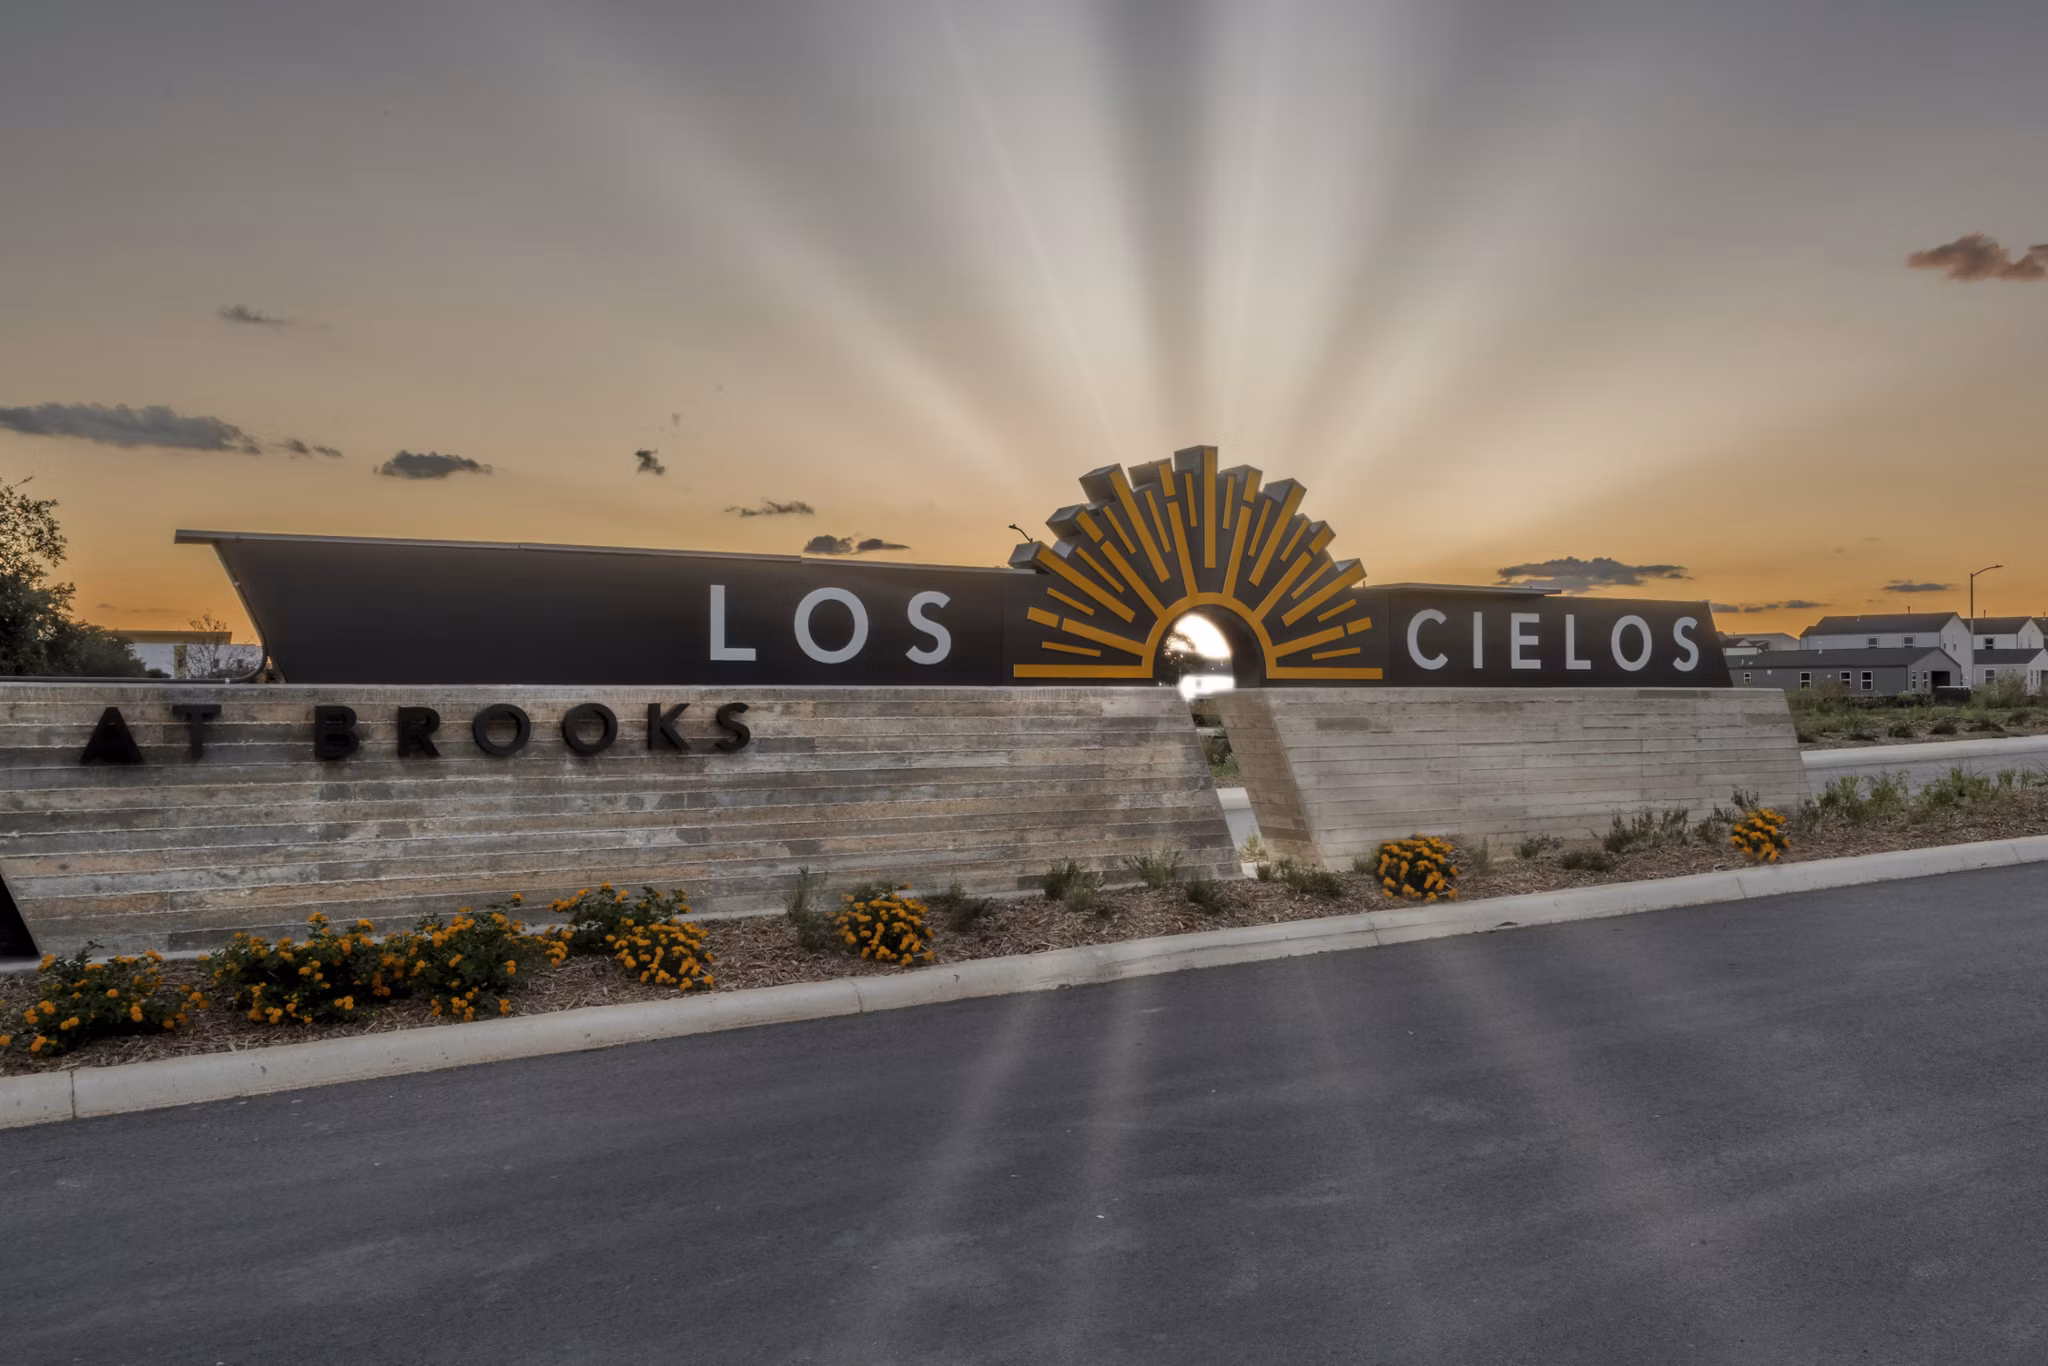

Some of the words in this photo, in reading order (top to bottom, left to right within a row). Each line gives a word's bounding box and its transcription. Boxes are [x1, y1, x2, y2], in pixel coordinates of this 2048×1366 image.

[709, 584, 952, 666] LOS
[1405, 608, 1700, 673] CIELOS
[79, 703, 223, 765] AT
[314, 701, 751, 761] BROOKS
